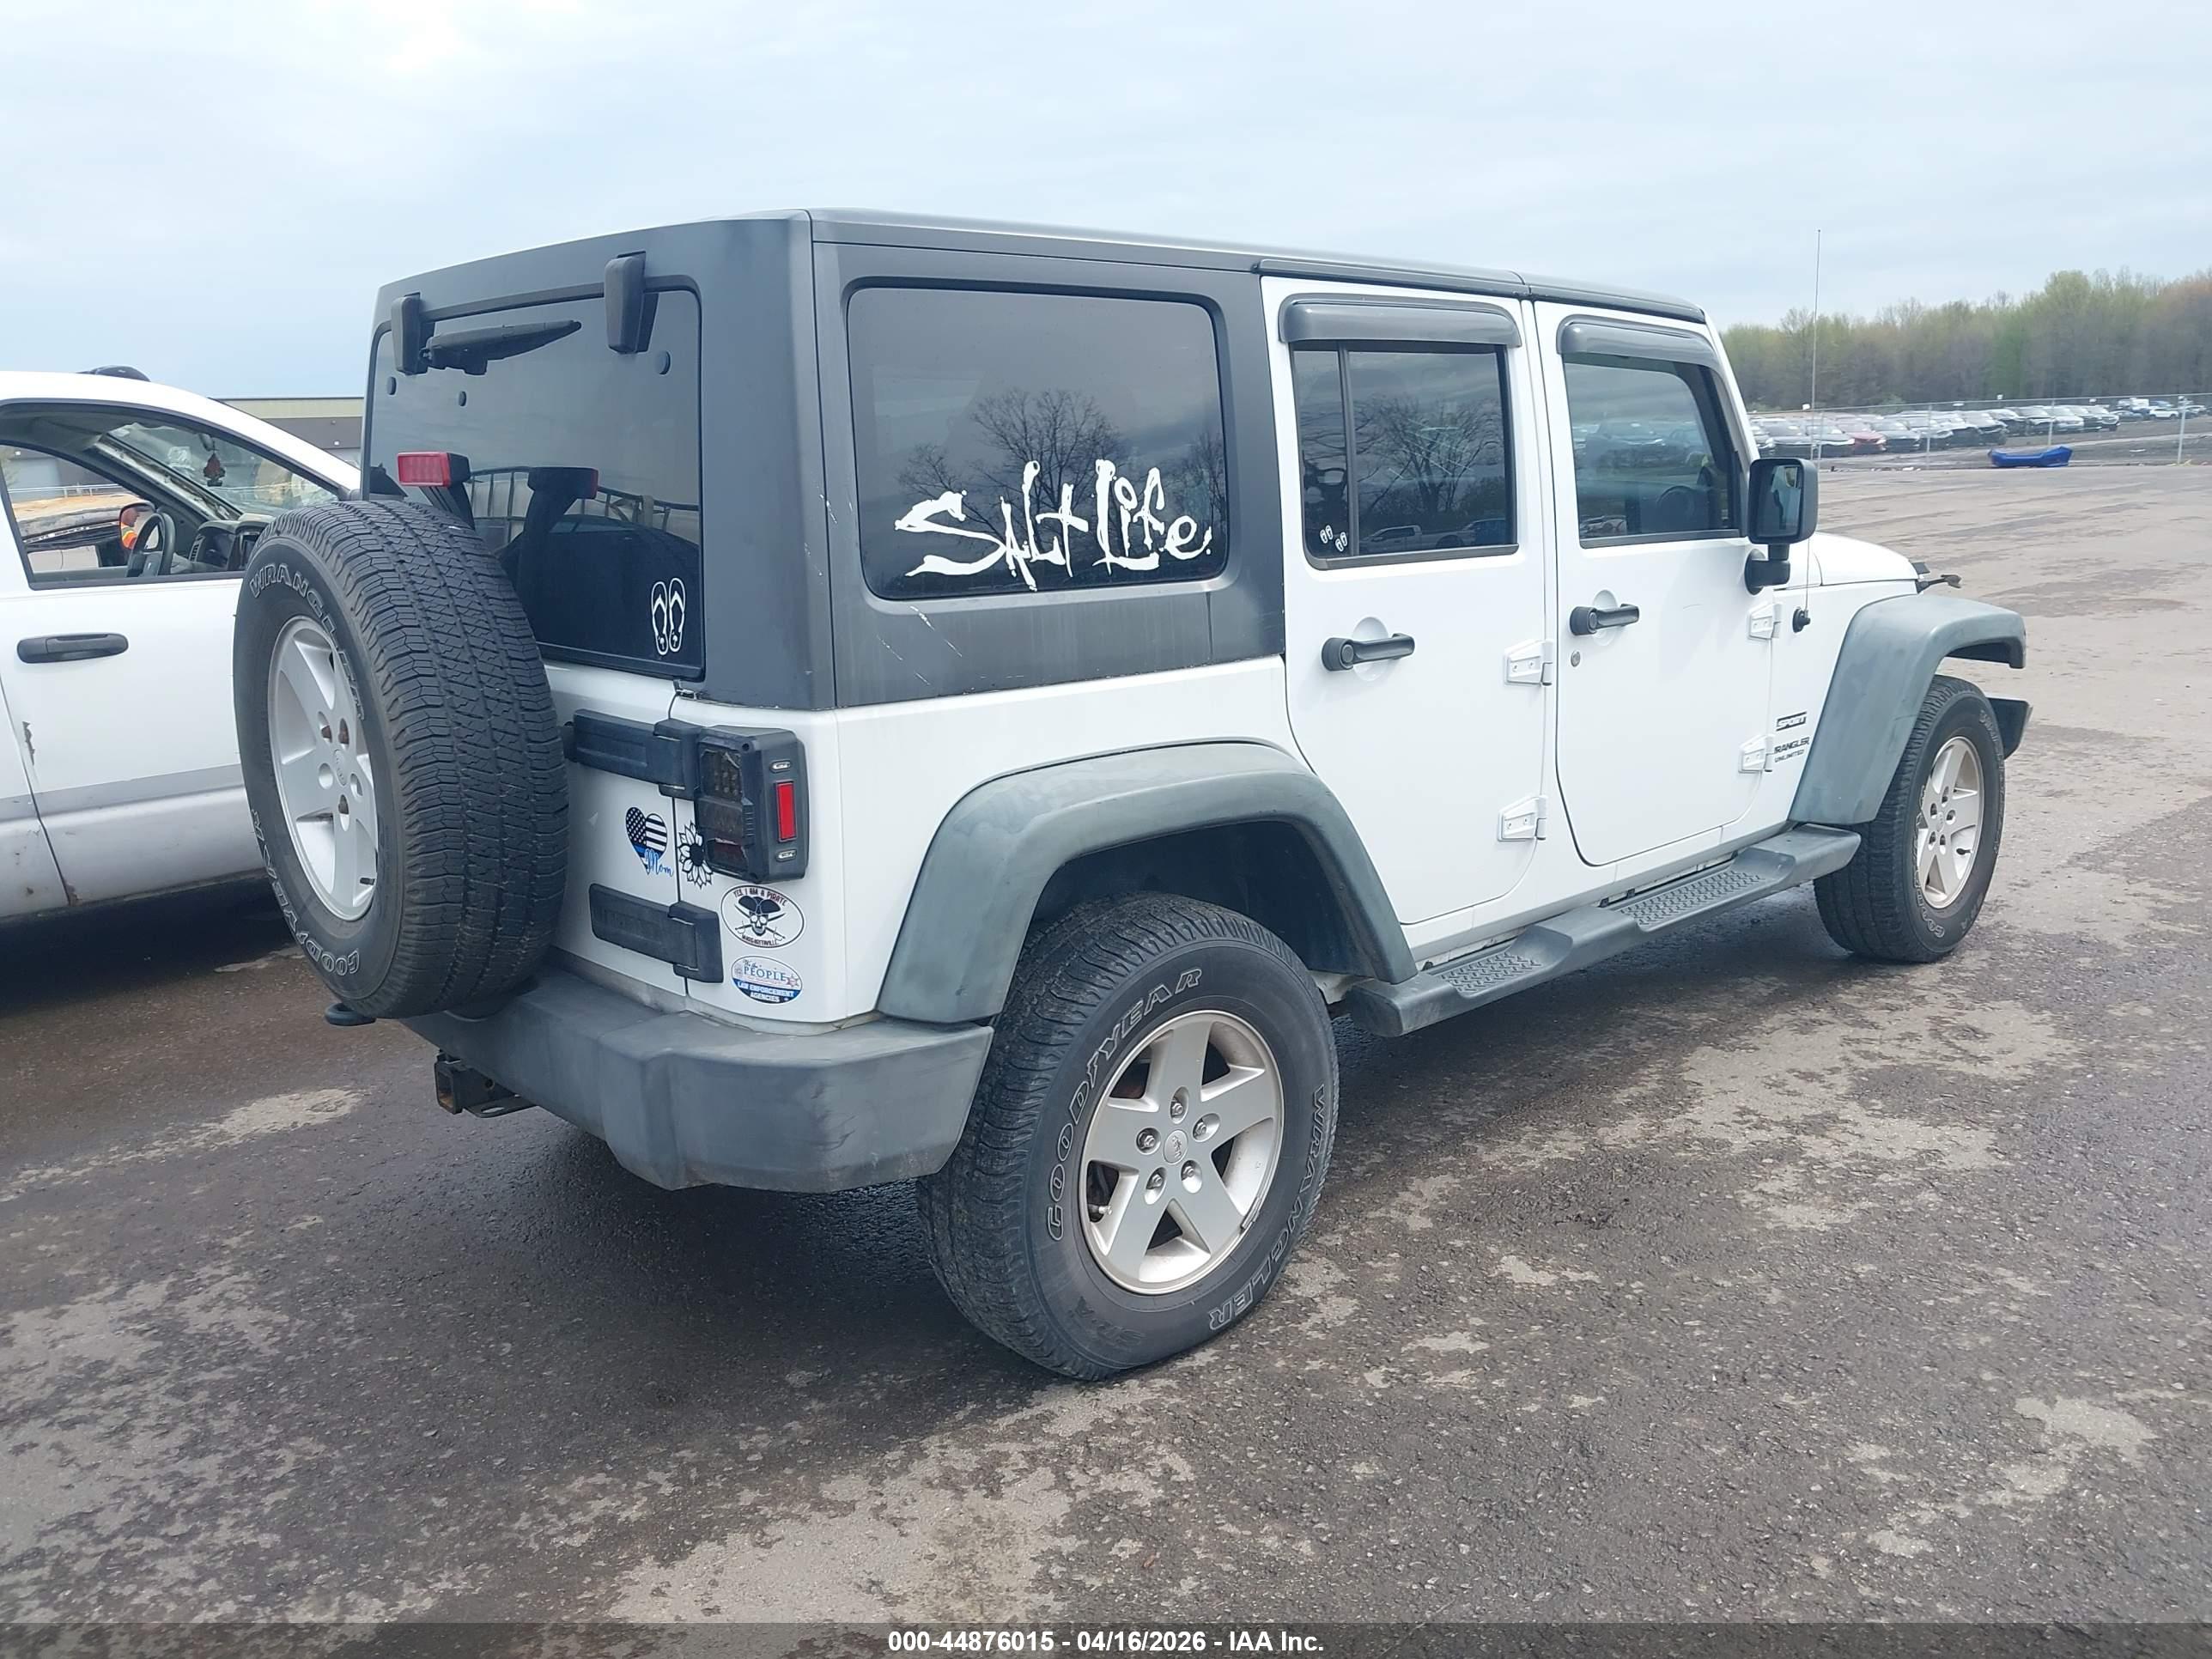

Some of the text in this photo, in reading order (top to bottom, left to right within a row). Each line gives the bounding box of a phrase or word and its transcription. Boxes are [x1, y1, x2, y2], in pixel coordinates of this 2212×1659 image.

[644, 848, 674, 877] Mom
[767, 891, 788, 907] PIRATE
[744, 966, 786, 981] PEOPLE
[1047, 969, 1201, 1241] GOODYEAR
[1209, 1083, 1326, 1331] WRANGLER
